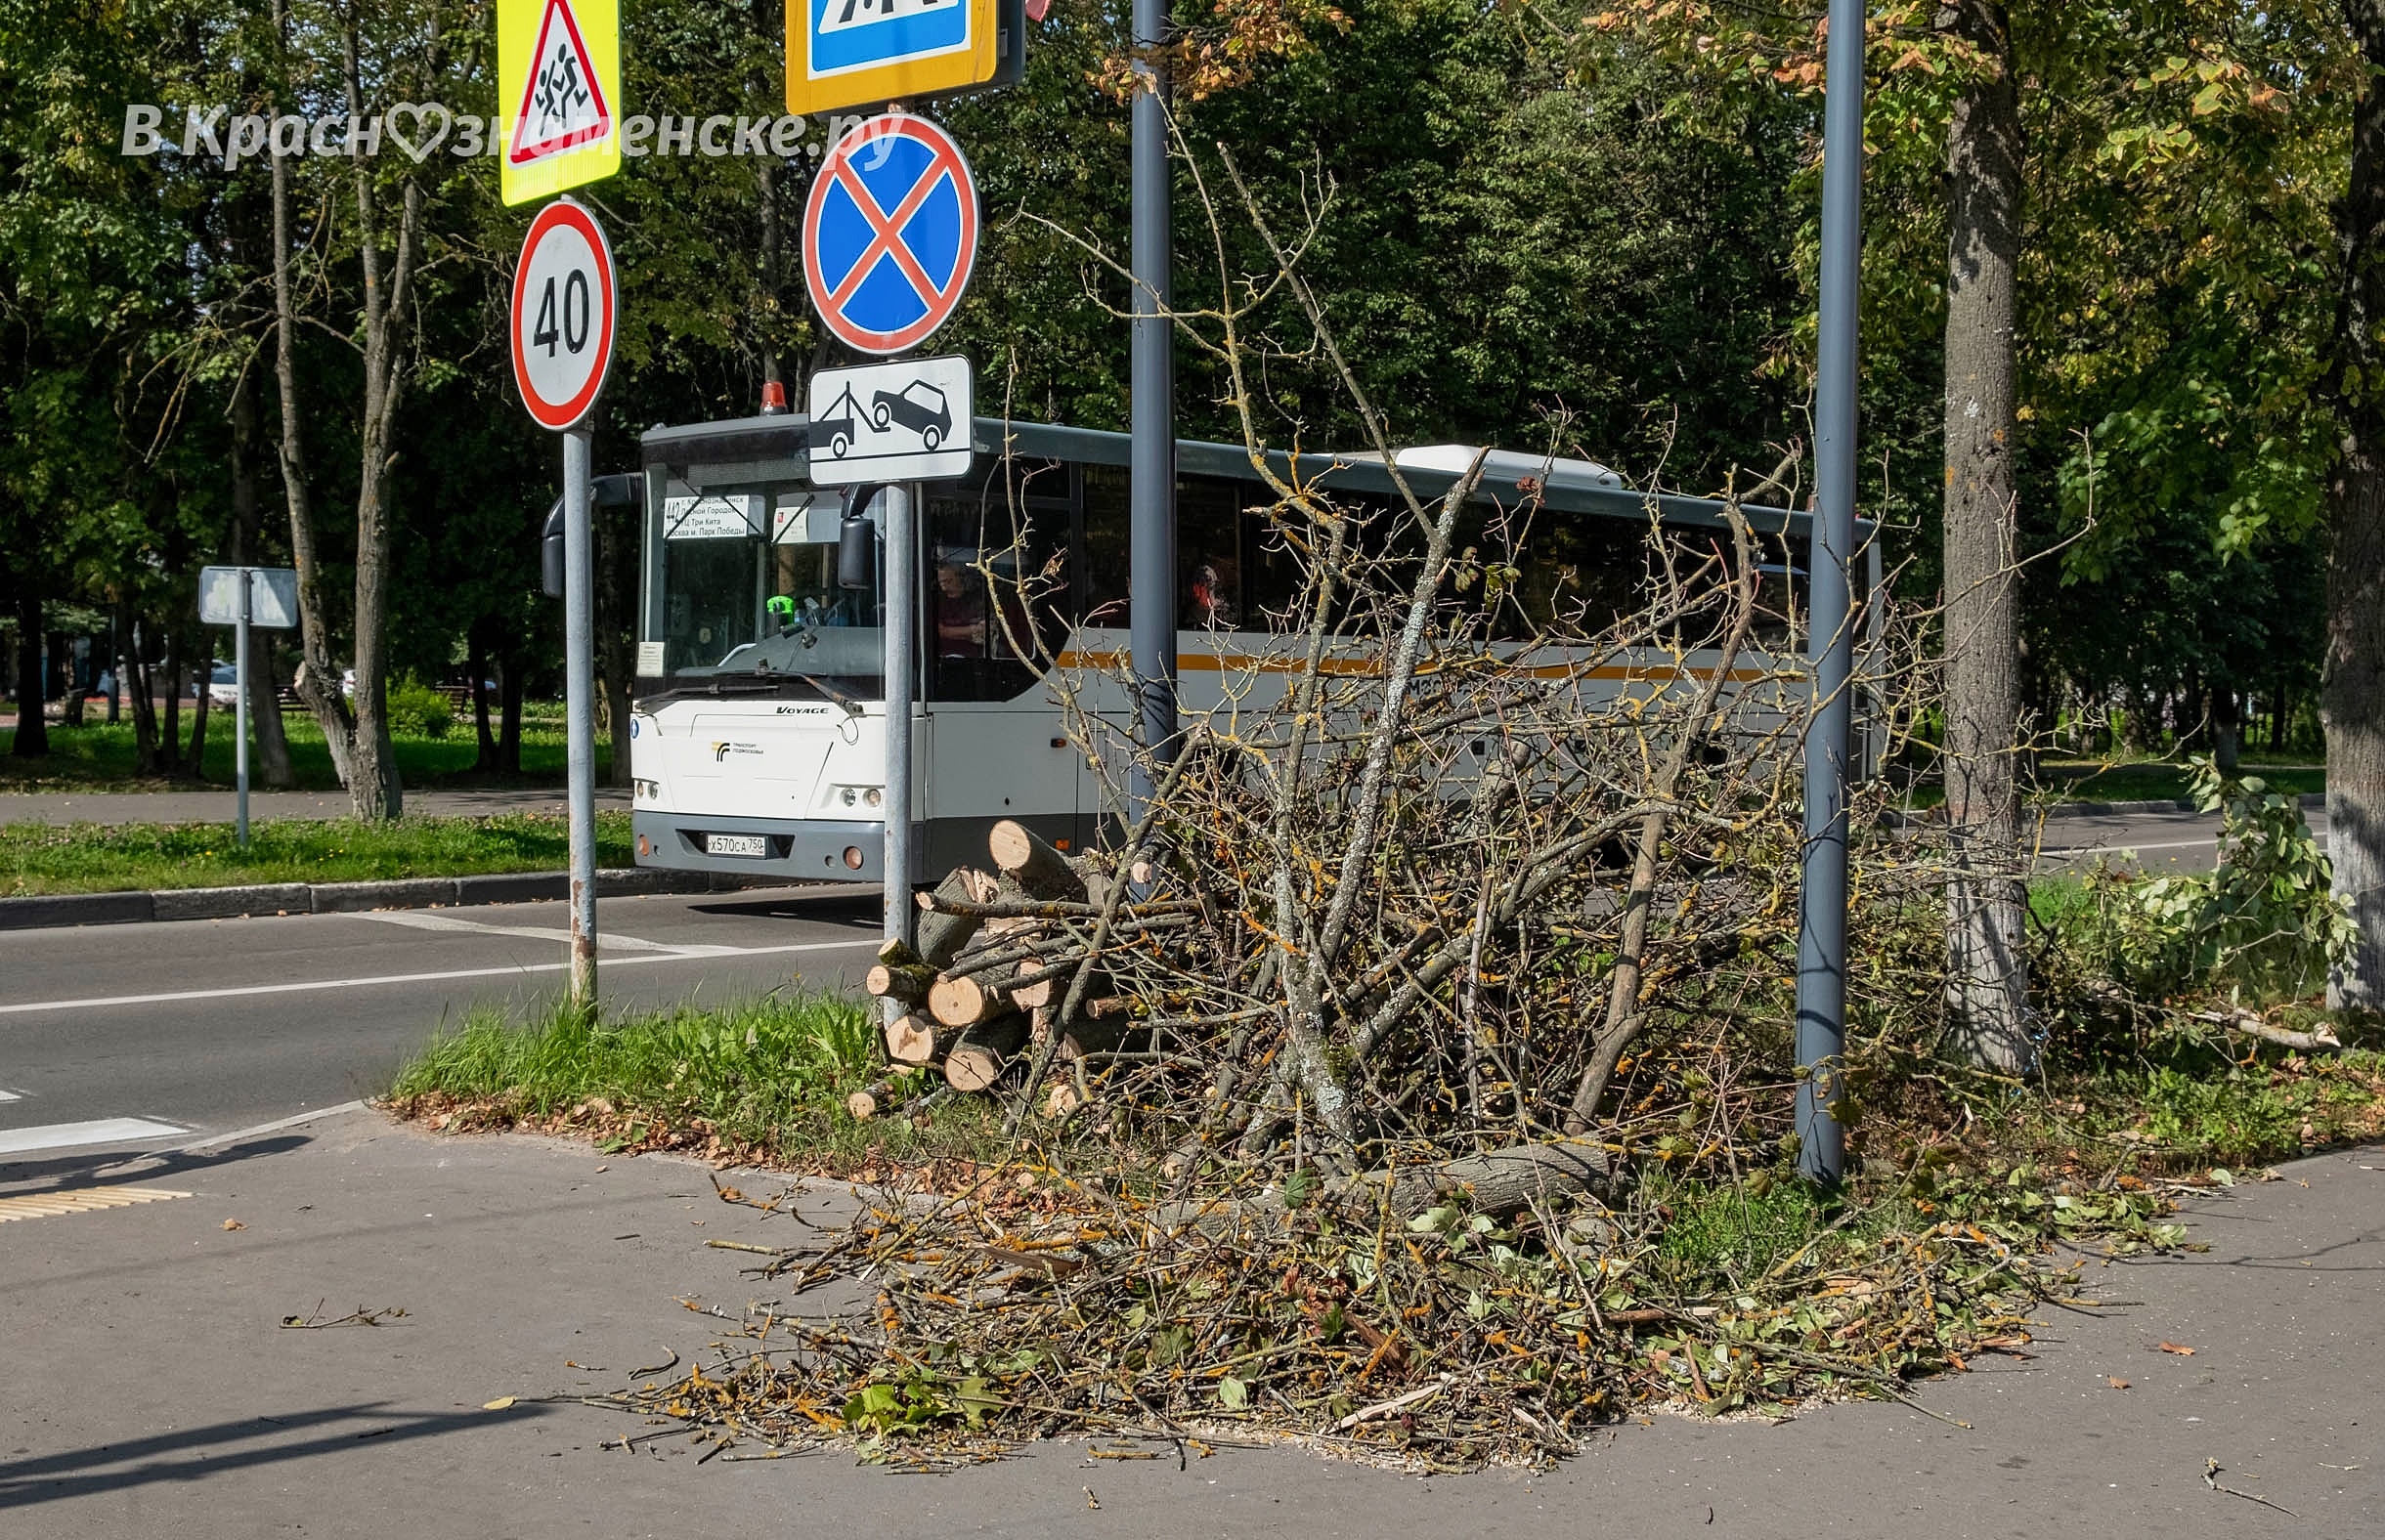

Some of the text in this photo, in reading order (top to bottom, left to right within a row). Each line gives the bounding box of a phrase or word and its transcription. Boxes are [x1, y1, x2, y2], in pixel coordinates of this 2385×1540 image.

[533, 268, 589, 359] 40
[691, 518, 705, 527] Три
[699, 527, 716, 536] Парк
[716, 526, 746, 535] Победы
[748, 837, 762, 849] 750
